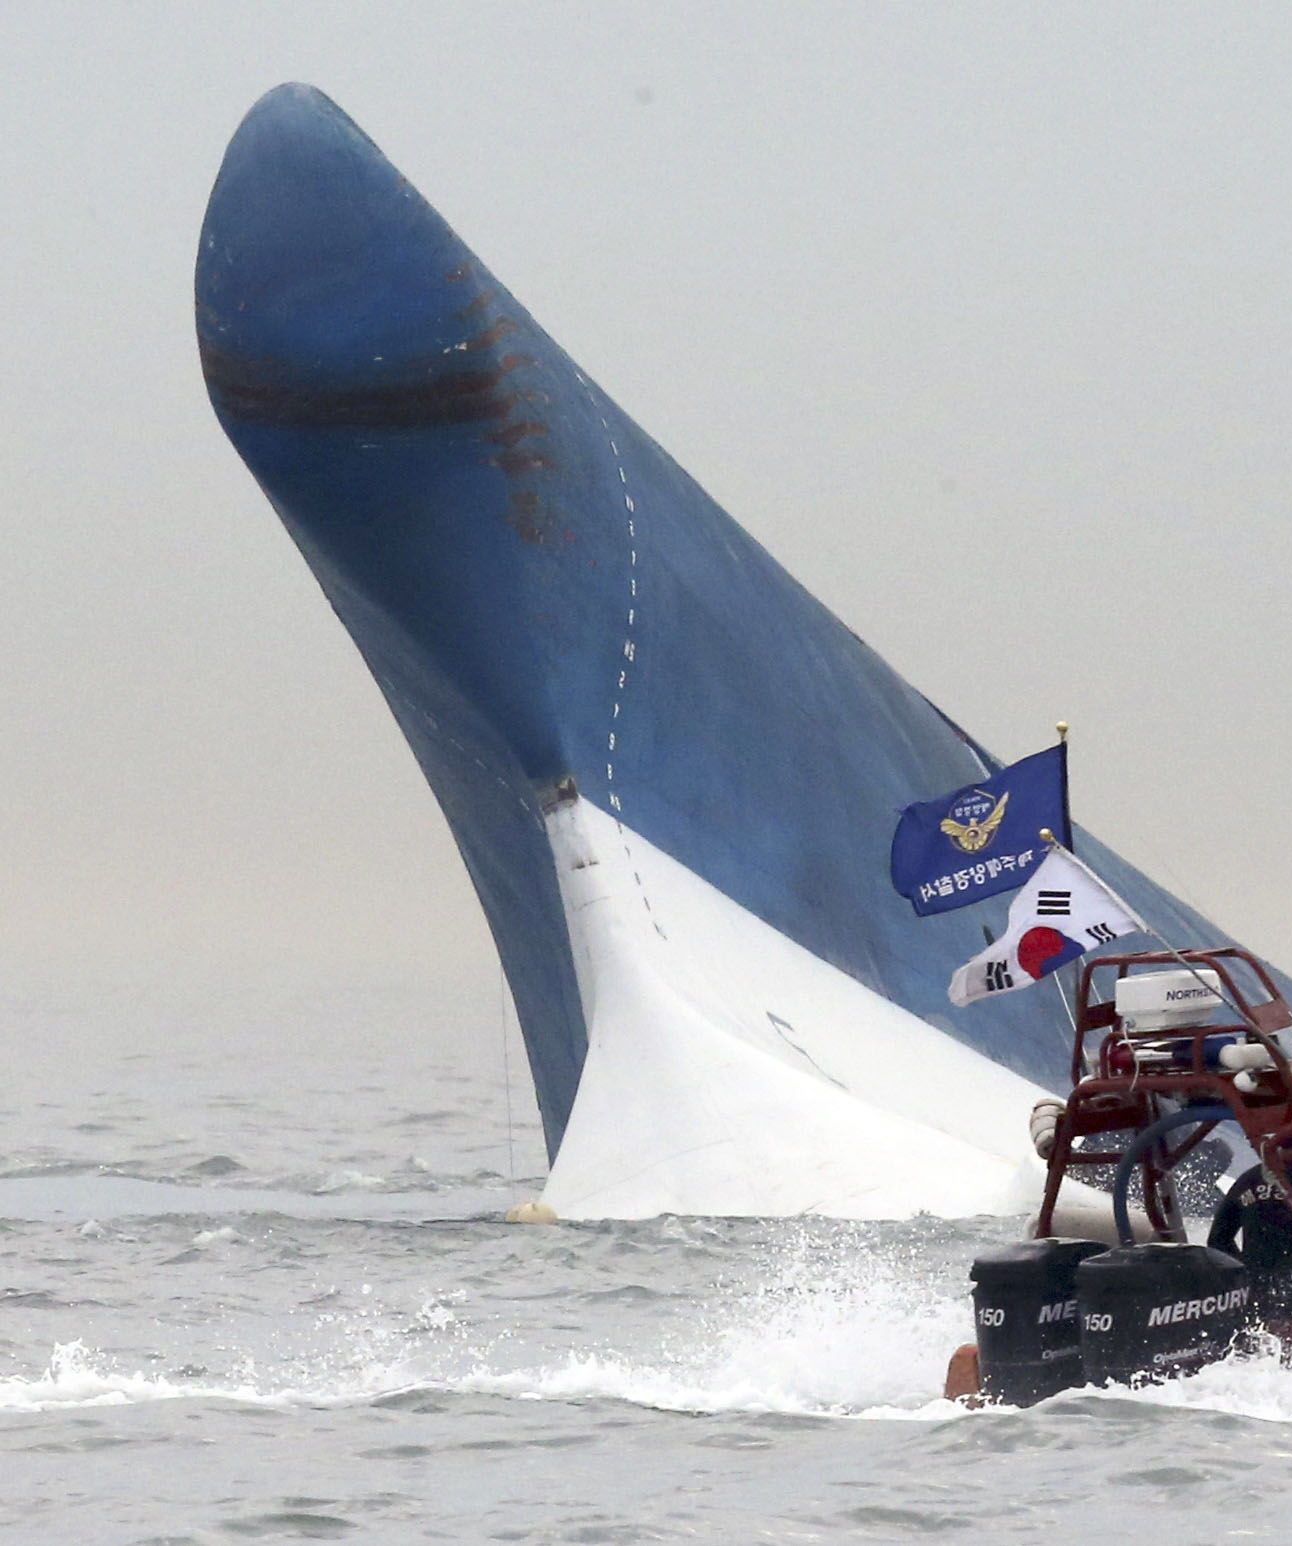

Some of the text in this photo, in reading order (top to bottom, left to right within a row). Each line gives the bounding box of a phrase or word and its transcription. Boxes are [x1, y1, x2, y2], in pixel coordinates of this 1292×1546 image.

[1147, 1286, 1251, 1327] MERCURY
[979, 1307, 1006, 1327] 150
[1084, 1313, 1113, 1332] 150
